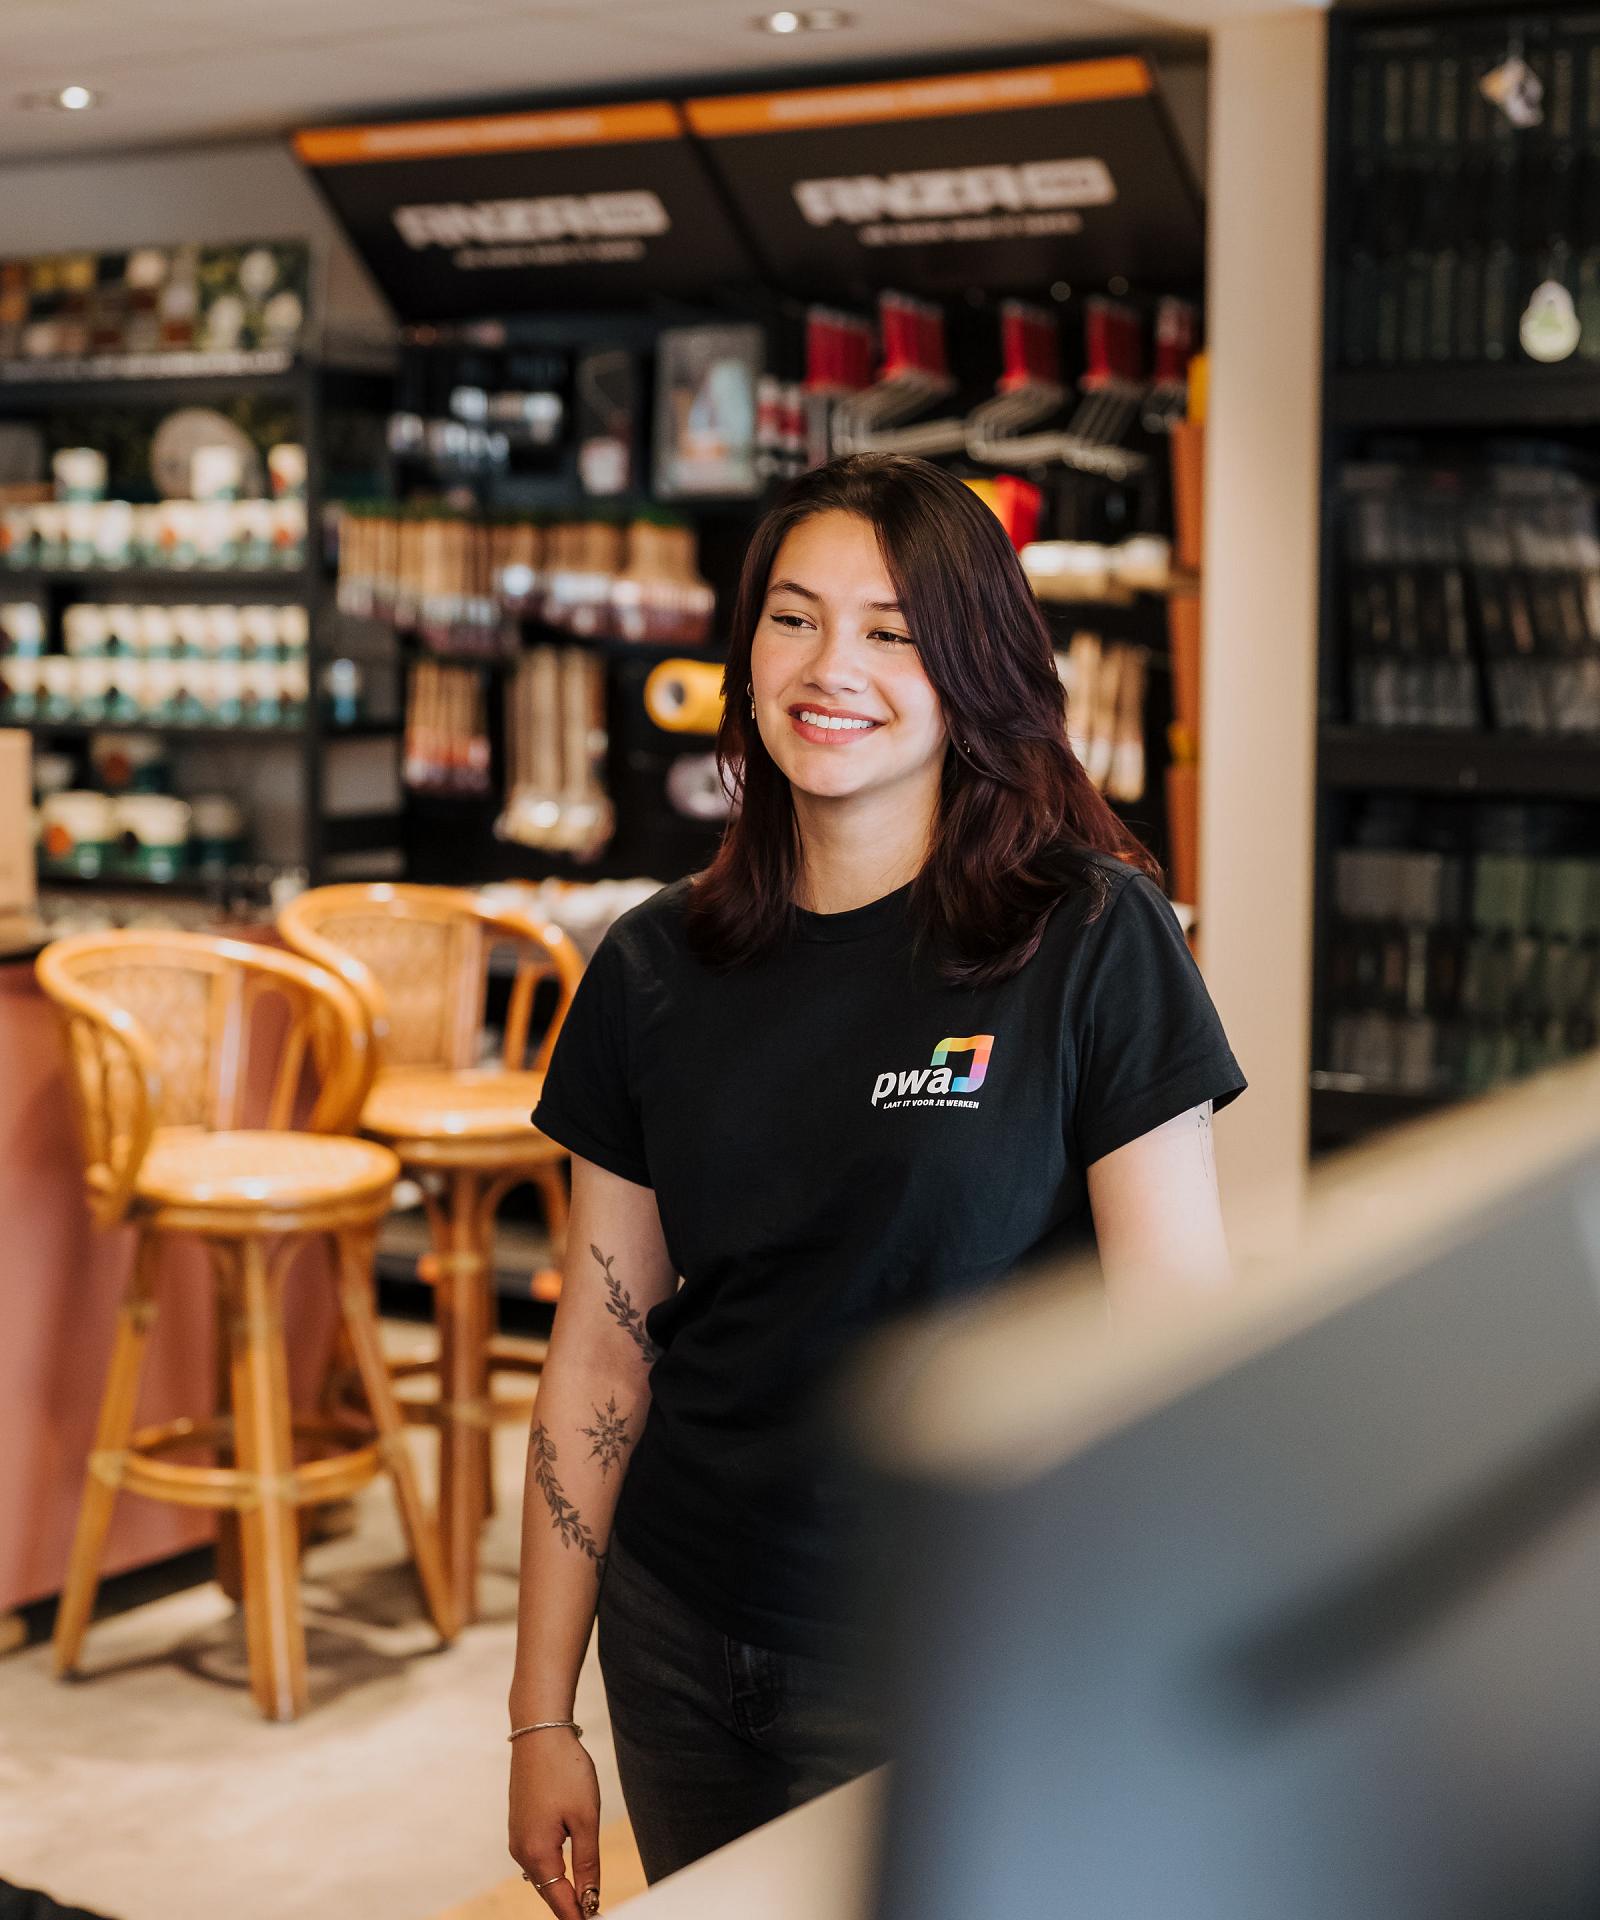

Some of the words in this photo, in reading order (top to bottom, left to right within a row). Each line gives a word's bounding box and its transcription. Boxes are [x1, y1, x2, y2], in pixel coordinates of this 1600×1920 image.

[871, 1067, 953, 1107] pwa
[883, 1101, 902, 1110] LAAT
[912, 1099, 934, 1107] VOOR
[935, 1099, 945, 1107] JE
[946, 1099, 980, 1110] WERKEN
